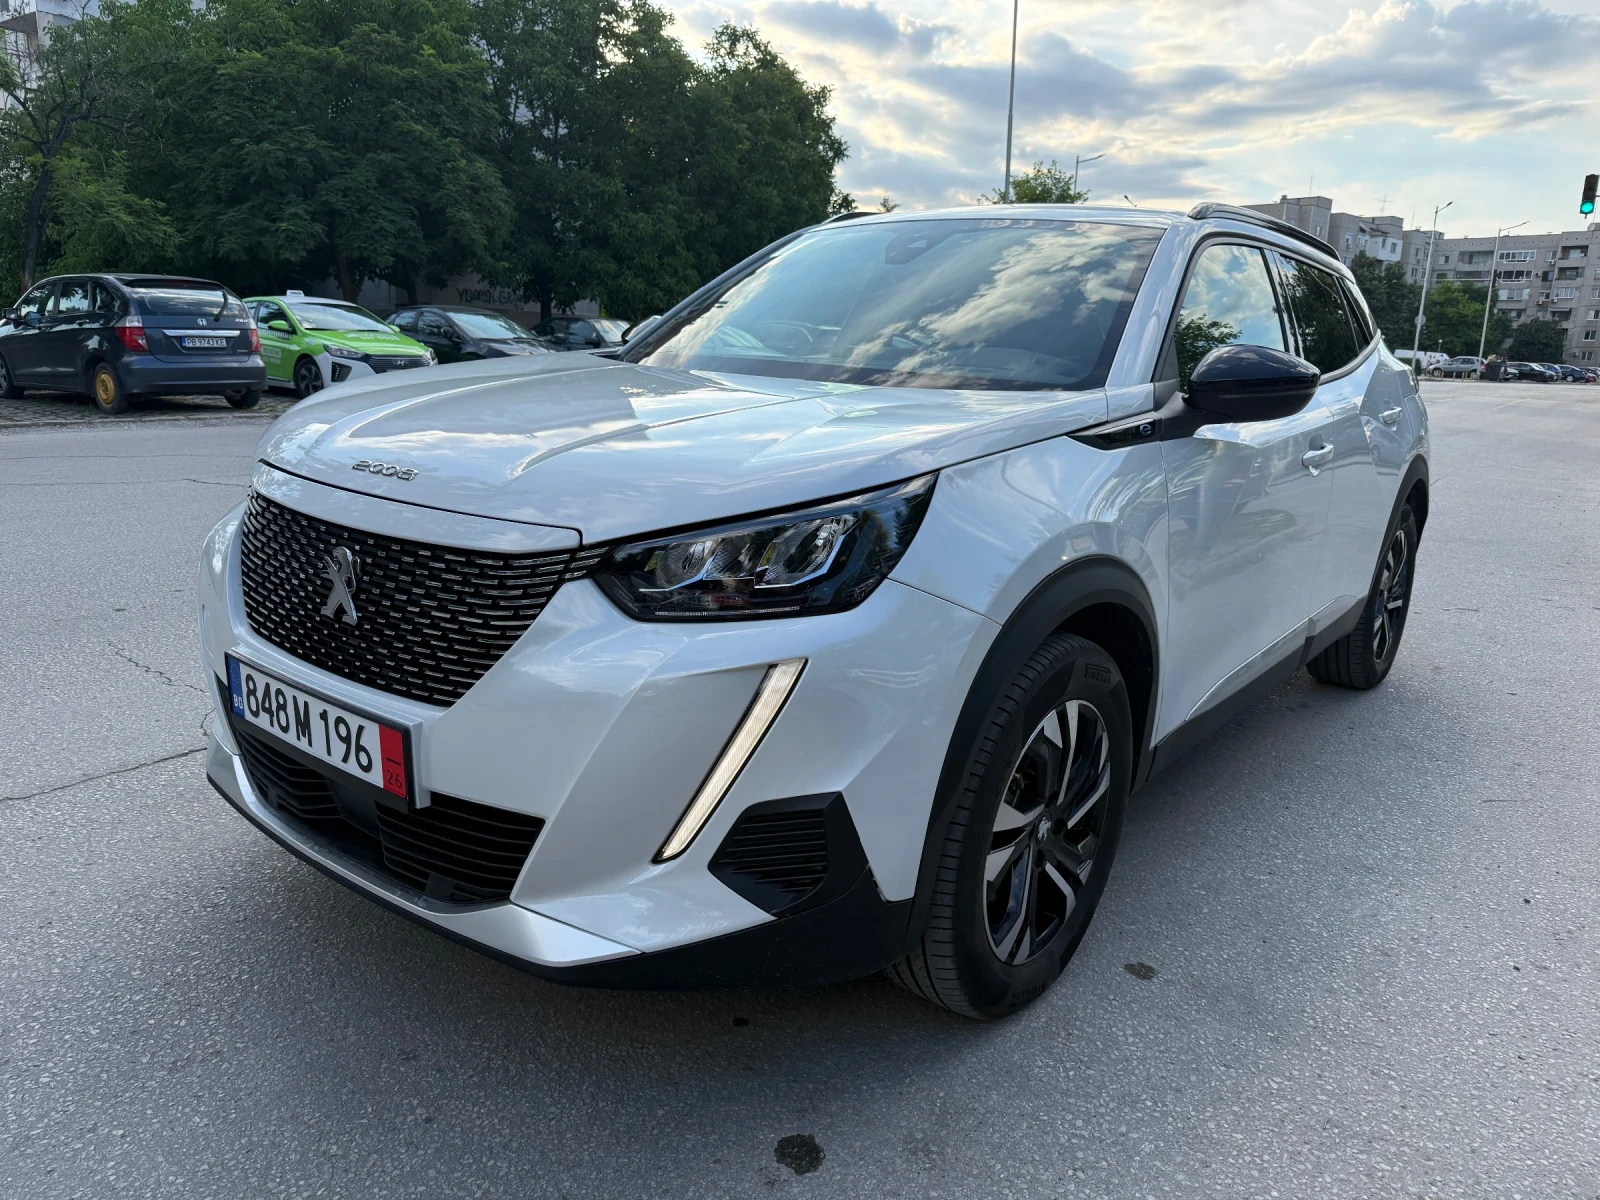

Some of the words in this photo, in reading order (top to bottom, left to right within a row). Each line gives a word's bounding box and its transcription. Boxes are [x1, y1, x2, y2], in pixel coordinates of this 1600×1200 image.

[197, 338, 215, 347] 9743
[351, 459, 419, 481] 2008
[1083, 661, 1112, 685] PIRELLI
[233, 693, 244, 710] BG
[245, 673, 290, 734] 848
[319, 708, 373, 774] 196
[386, 769, 402, 789] 26
